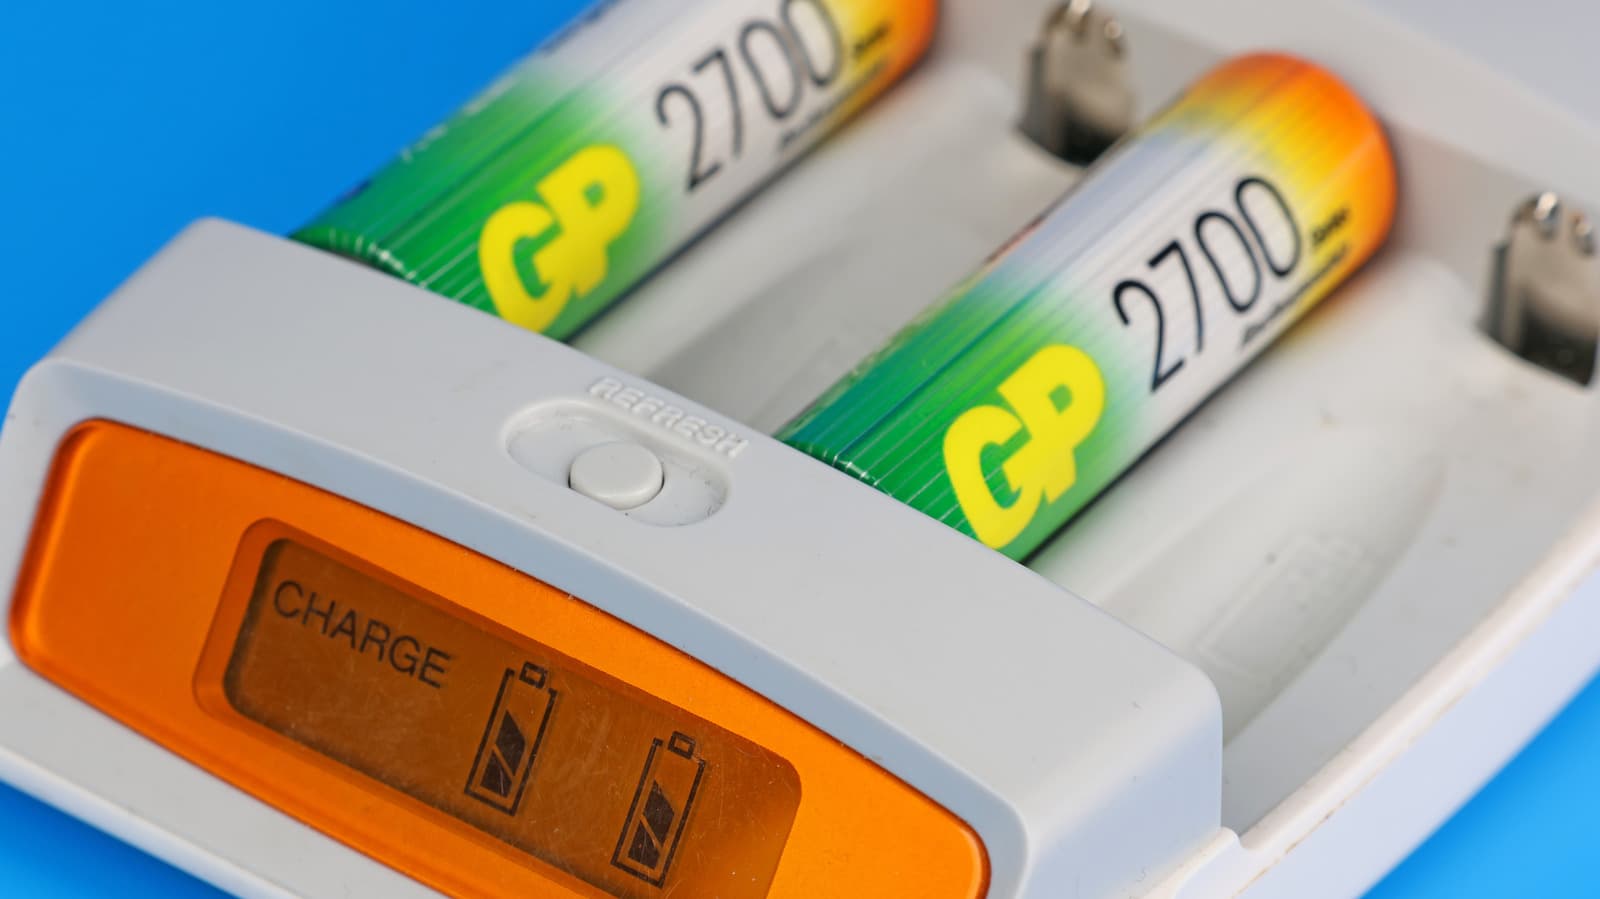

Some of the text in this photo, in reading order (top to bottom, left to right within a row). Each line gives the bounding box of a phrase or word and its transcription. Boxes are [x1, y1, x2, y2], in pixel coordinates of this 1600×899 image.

[655, 0, 842, 194] 2700
[479, 144, 640, 333] GP
[1112, 176, 1302, 394] 2700
[589, 376, 749, 459] REFRESH
[943, 344, 1106, 550] GP
[273, 580, 452, 690] CHARGE
